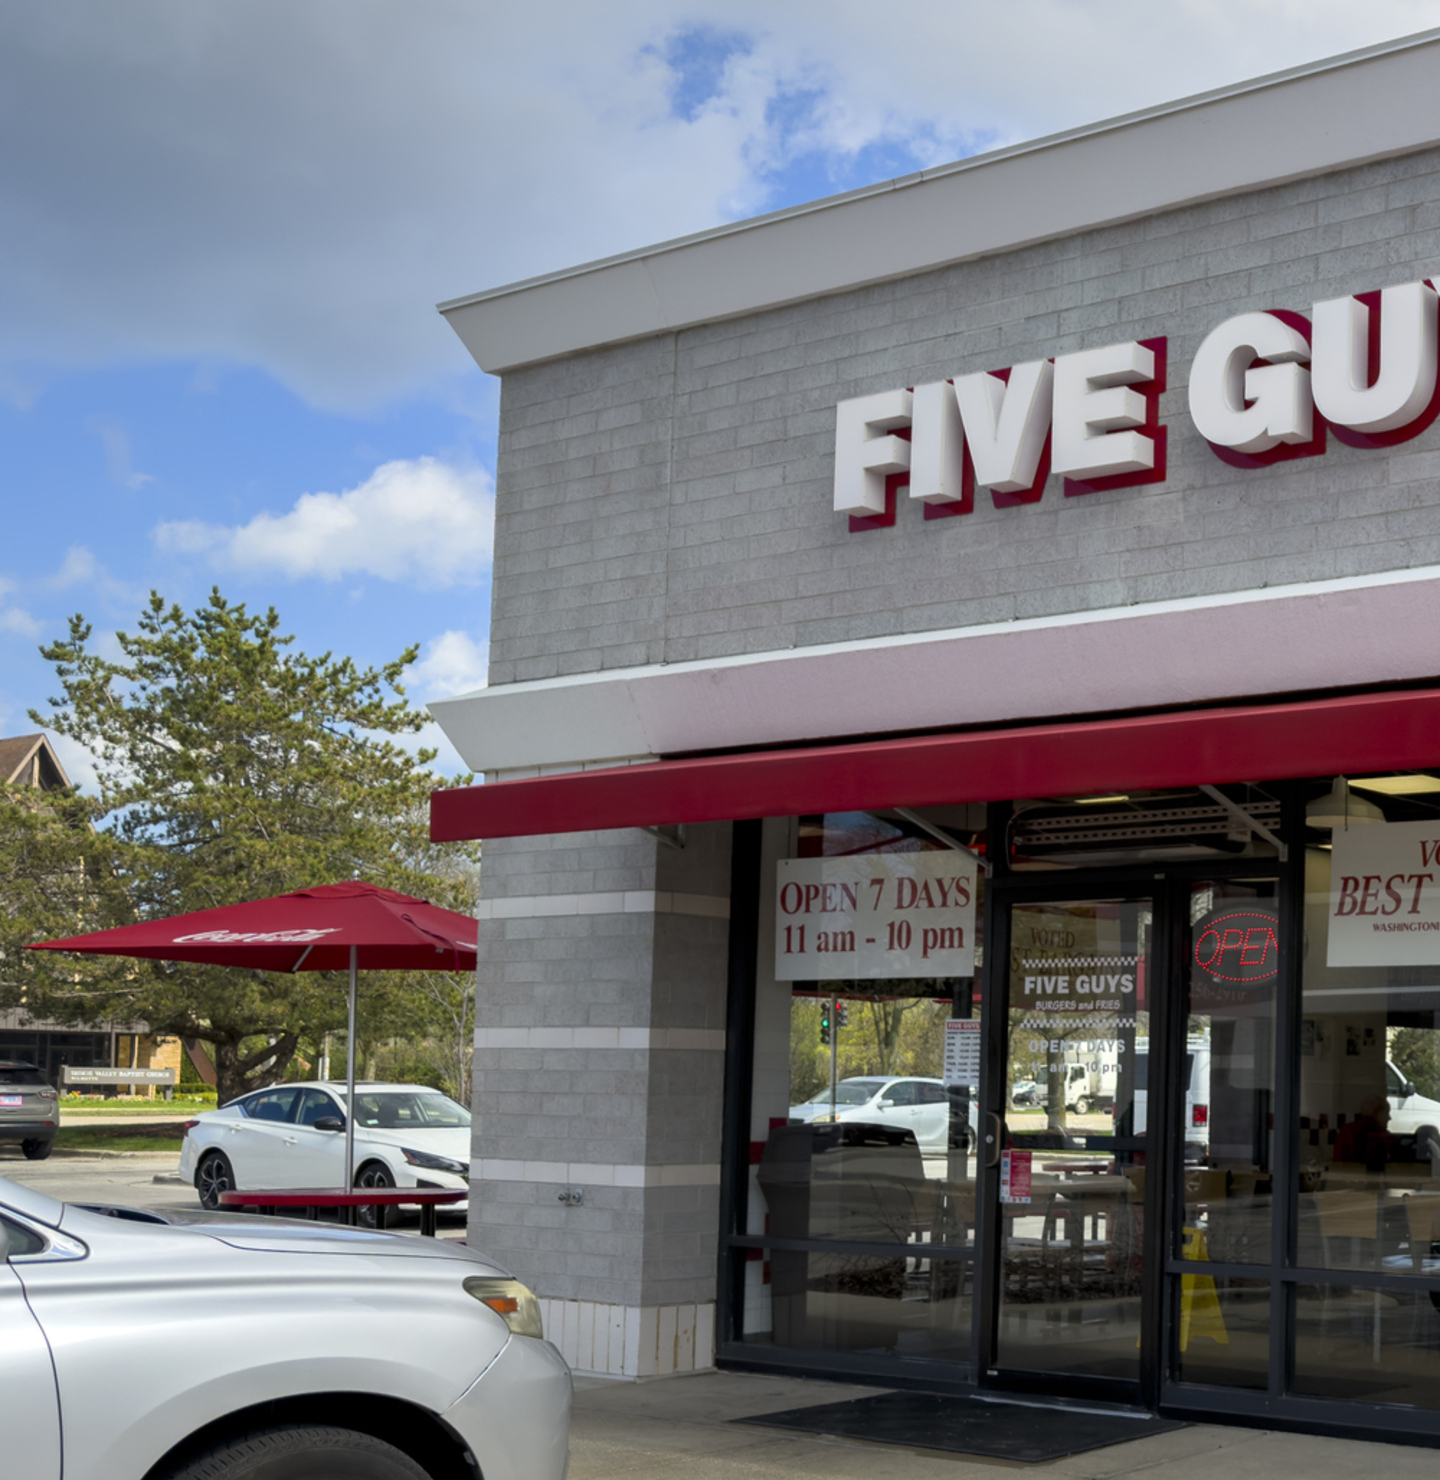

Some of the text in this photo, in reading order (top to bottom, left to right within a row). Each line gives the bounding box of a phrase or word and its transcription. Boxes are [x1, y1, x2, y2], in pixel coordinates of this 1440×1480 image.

[833, 337, 1166, 531] FIVE
[779, 876, 971, 915] OPEN 7 DAYS
[1334, 873, 1434, 916] BEST
[783, 924, 807, 954] 11
[816, 929, 856, 953] am
[886, 920, 912, 950] 10
[921, 926, 965, 959] pm
[1024, 974, 1134, 995] FIVE GUYS
[1035, 999, 1121, 1011] BURGERS and FRIES
[1028, 1040, 1070, 1053] OPEN
[1086, 1039, 1126, 1053] DAYS
